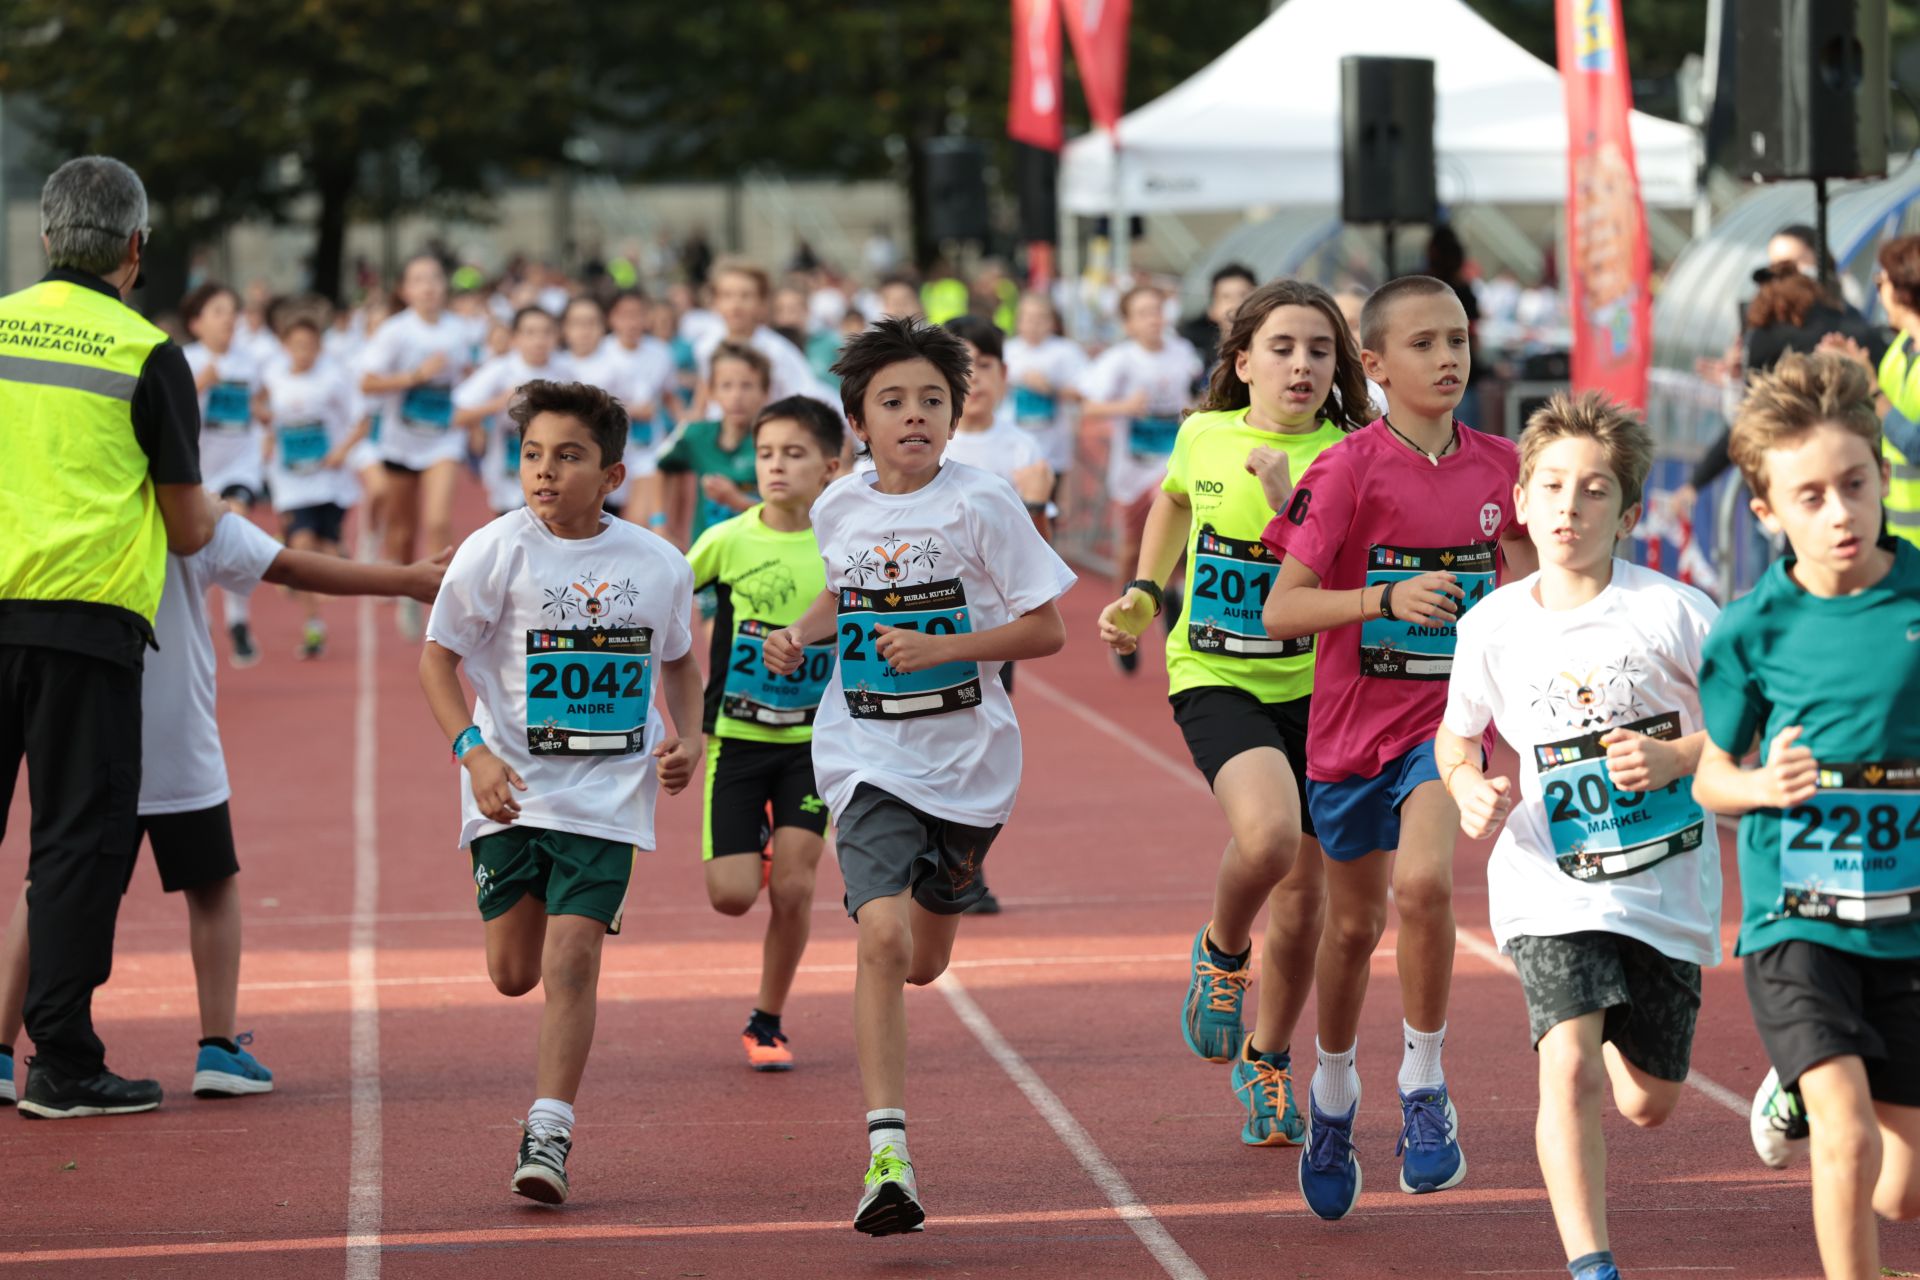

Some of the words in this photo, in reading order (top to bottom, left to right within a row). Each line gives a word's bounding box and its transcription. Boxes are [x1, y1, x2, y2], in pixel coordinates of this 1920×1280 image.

[904, 593, 928, 602] RURAL
[929, 588, 955, 598] KUTXA
[529, 661, 643, 699] 2042
[566, 703, 614, 714] ANDRE
[1587, 809, 1652, 834] MARKEL
[1833, 857, 1897, 871] MAURO
